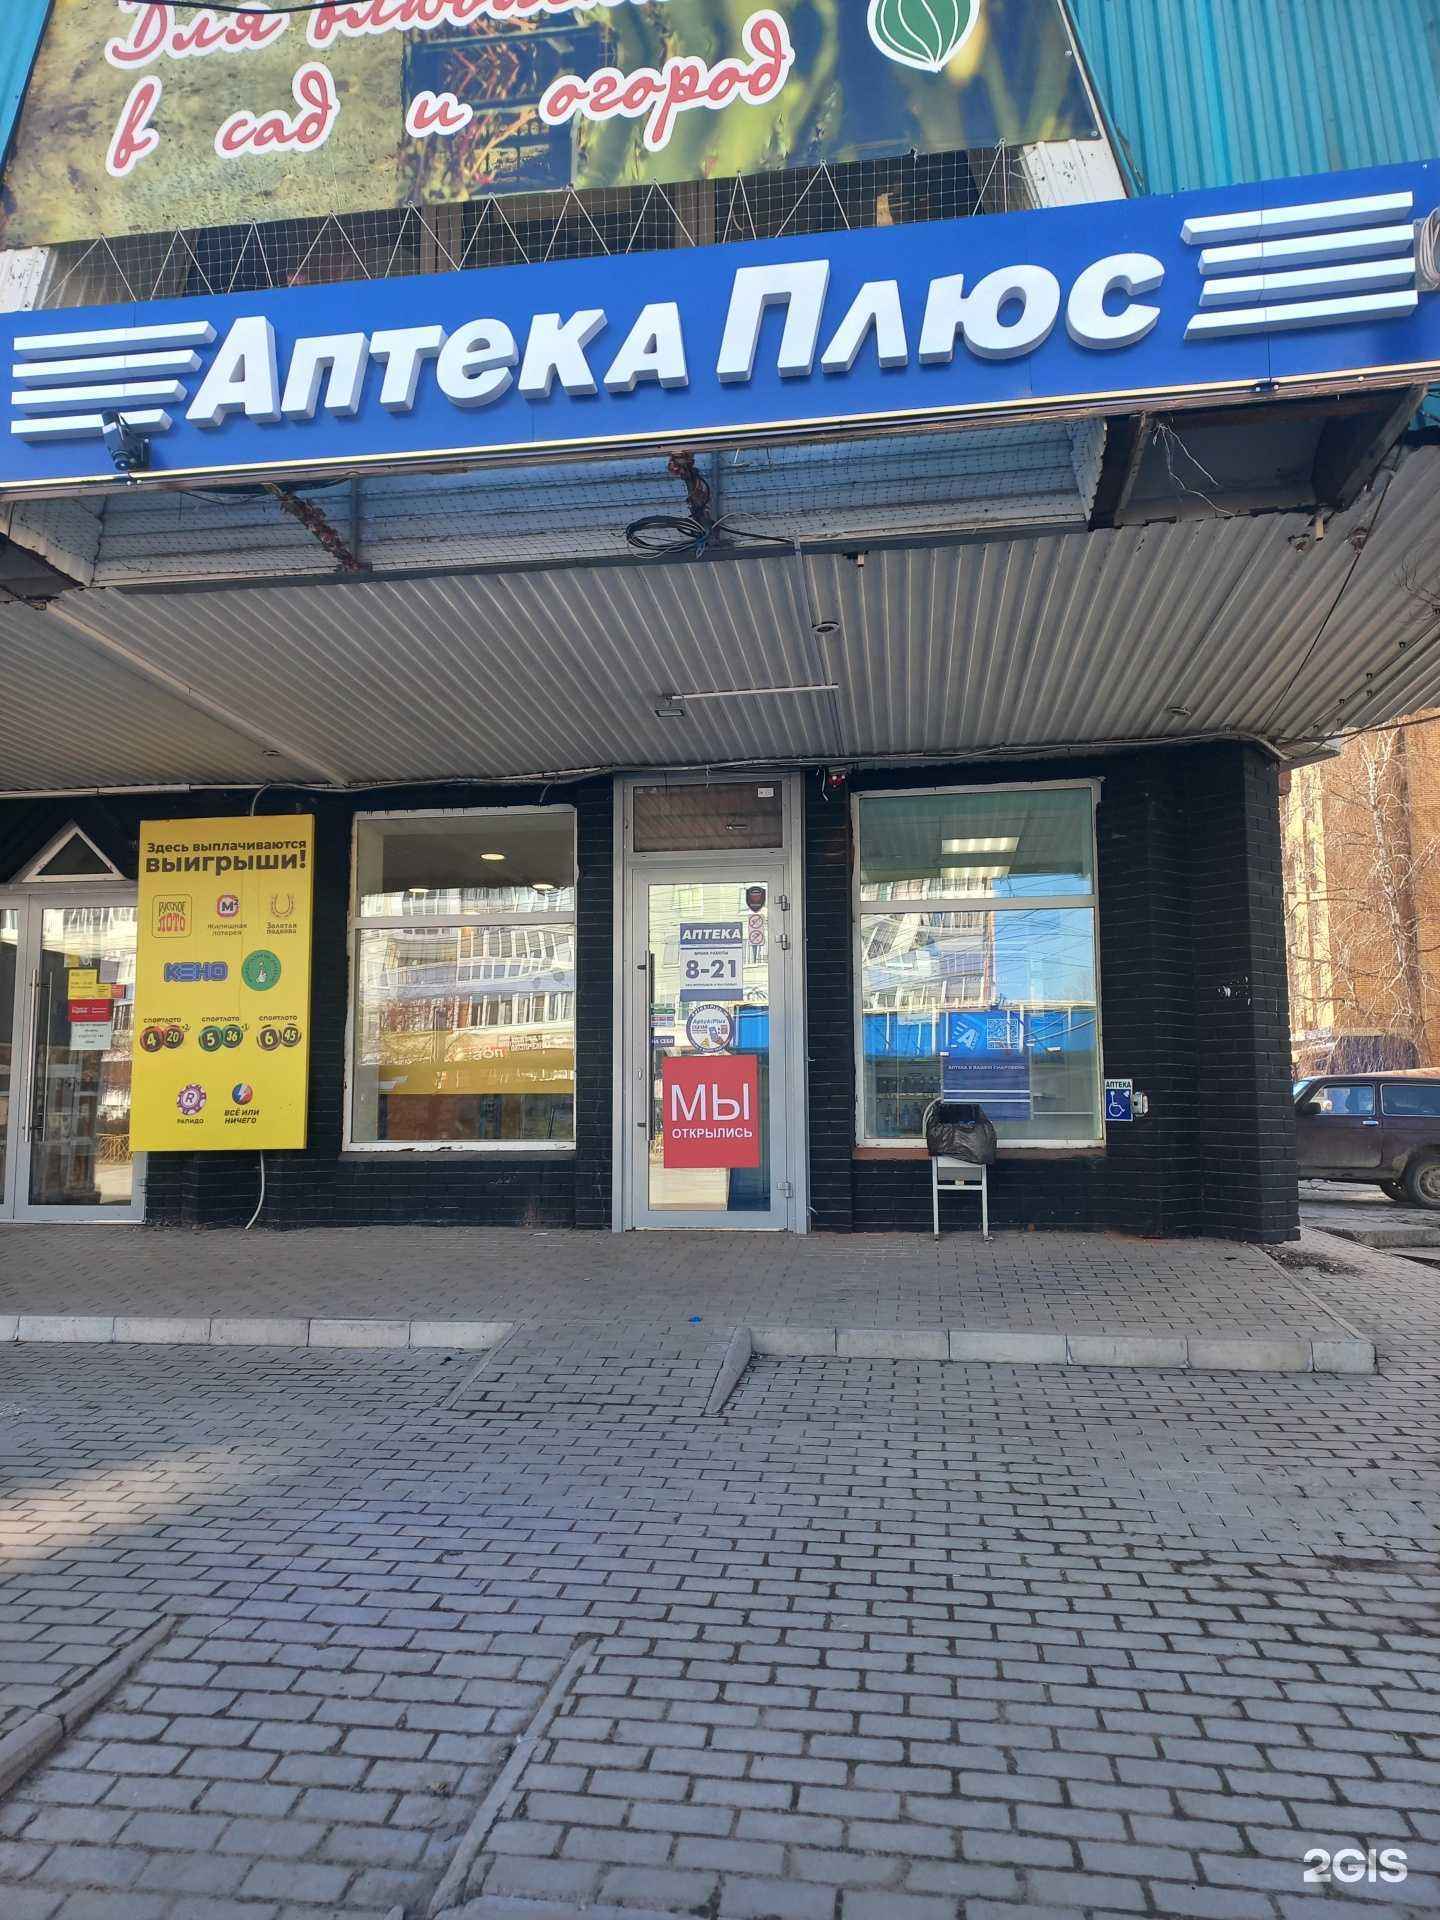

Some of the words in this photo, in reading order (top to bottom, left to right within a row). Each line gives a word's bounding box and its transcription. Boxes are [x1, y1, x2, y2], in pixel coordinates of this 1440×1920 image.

[112, 0, 283, 61] Для
[113, 83, 152, 169] в
[222, 70, 333, 151] сад
[413, 99, 465, 129] и
[547, 19, 787, 143] огород
[716, 252, 1166, 382] Плюс
[147, 842, 189, 854] Здесь
[192, 840, 307, 852] выплачиваются
[146, 850, 306, 876] выигрыши!
[682, 928, 741, 940] АПТЕКА
[685, 959, 737, 979] 8-21
[206, 1032, 216, 1046] 5
[226, 1030, 238, 1042] 36
[265, 1031, 274, 1045] 6
[284, 1029, 296, 1041] 45
[671, 1083, 750, 1121] МЫ
[672, 1127, 753, 1139] ОТКРЫЛИСЬ
